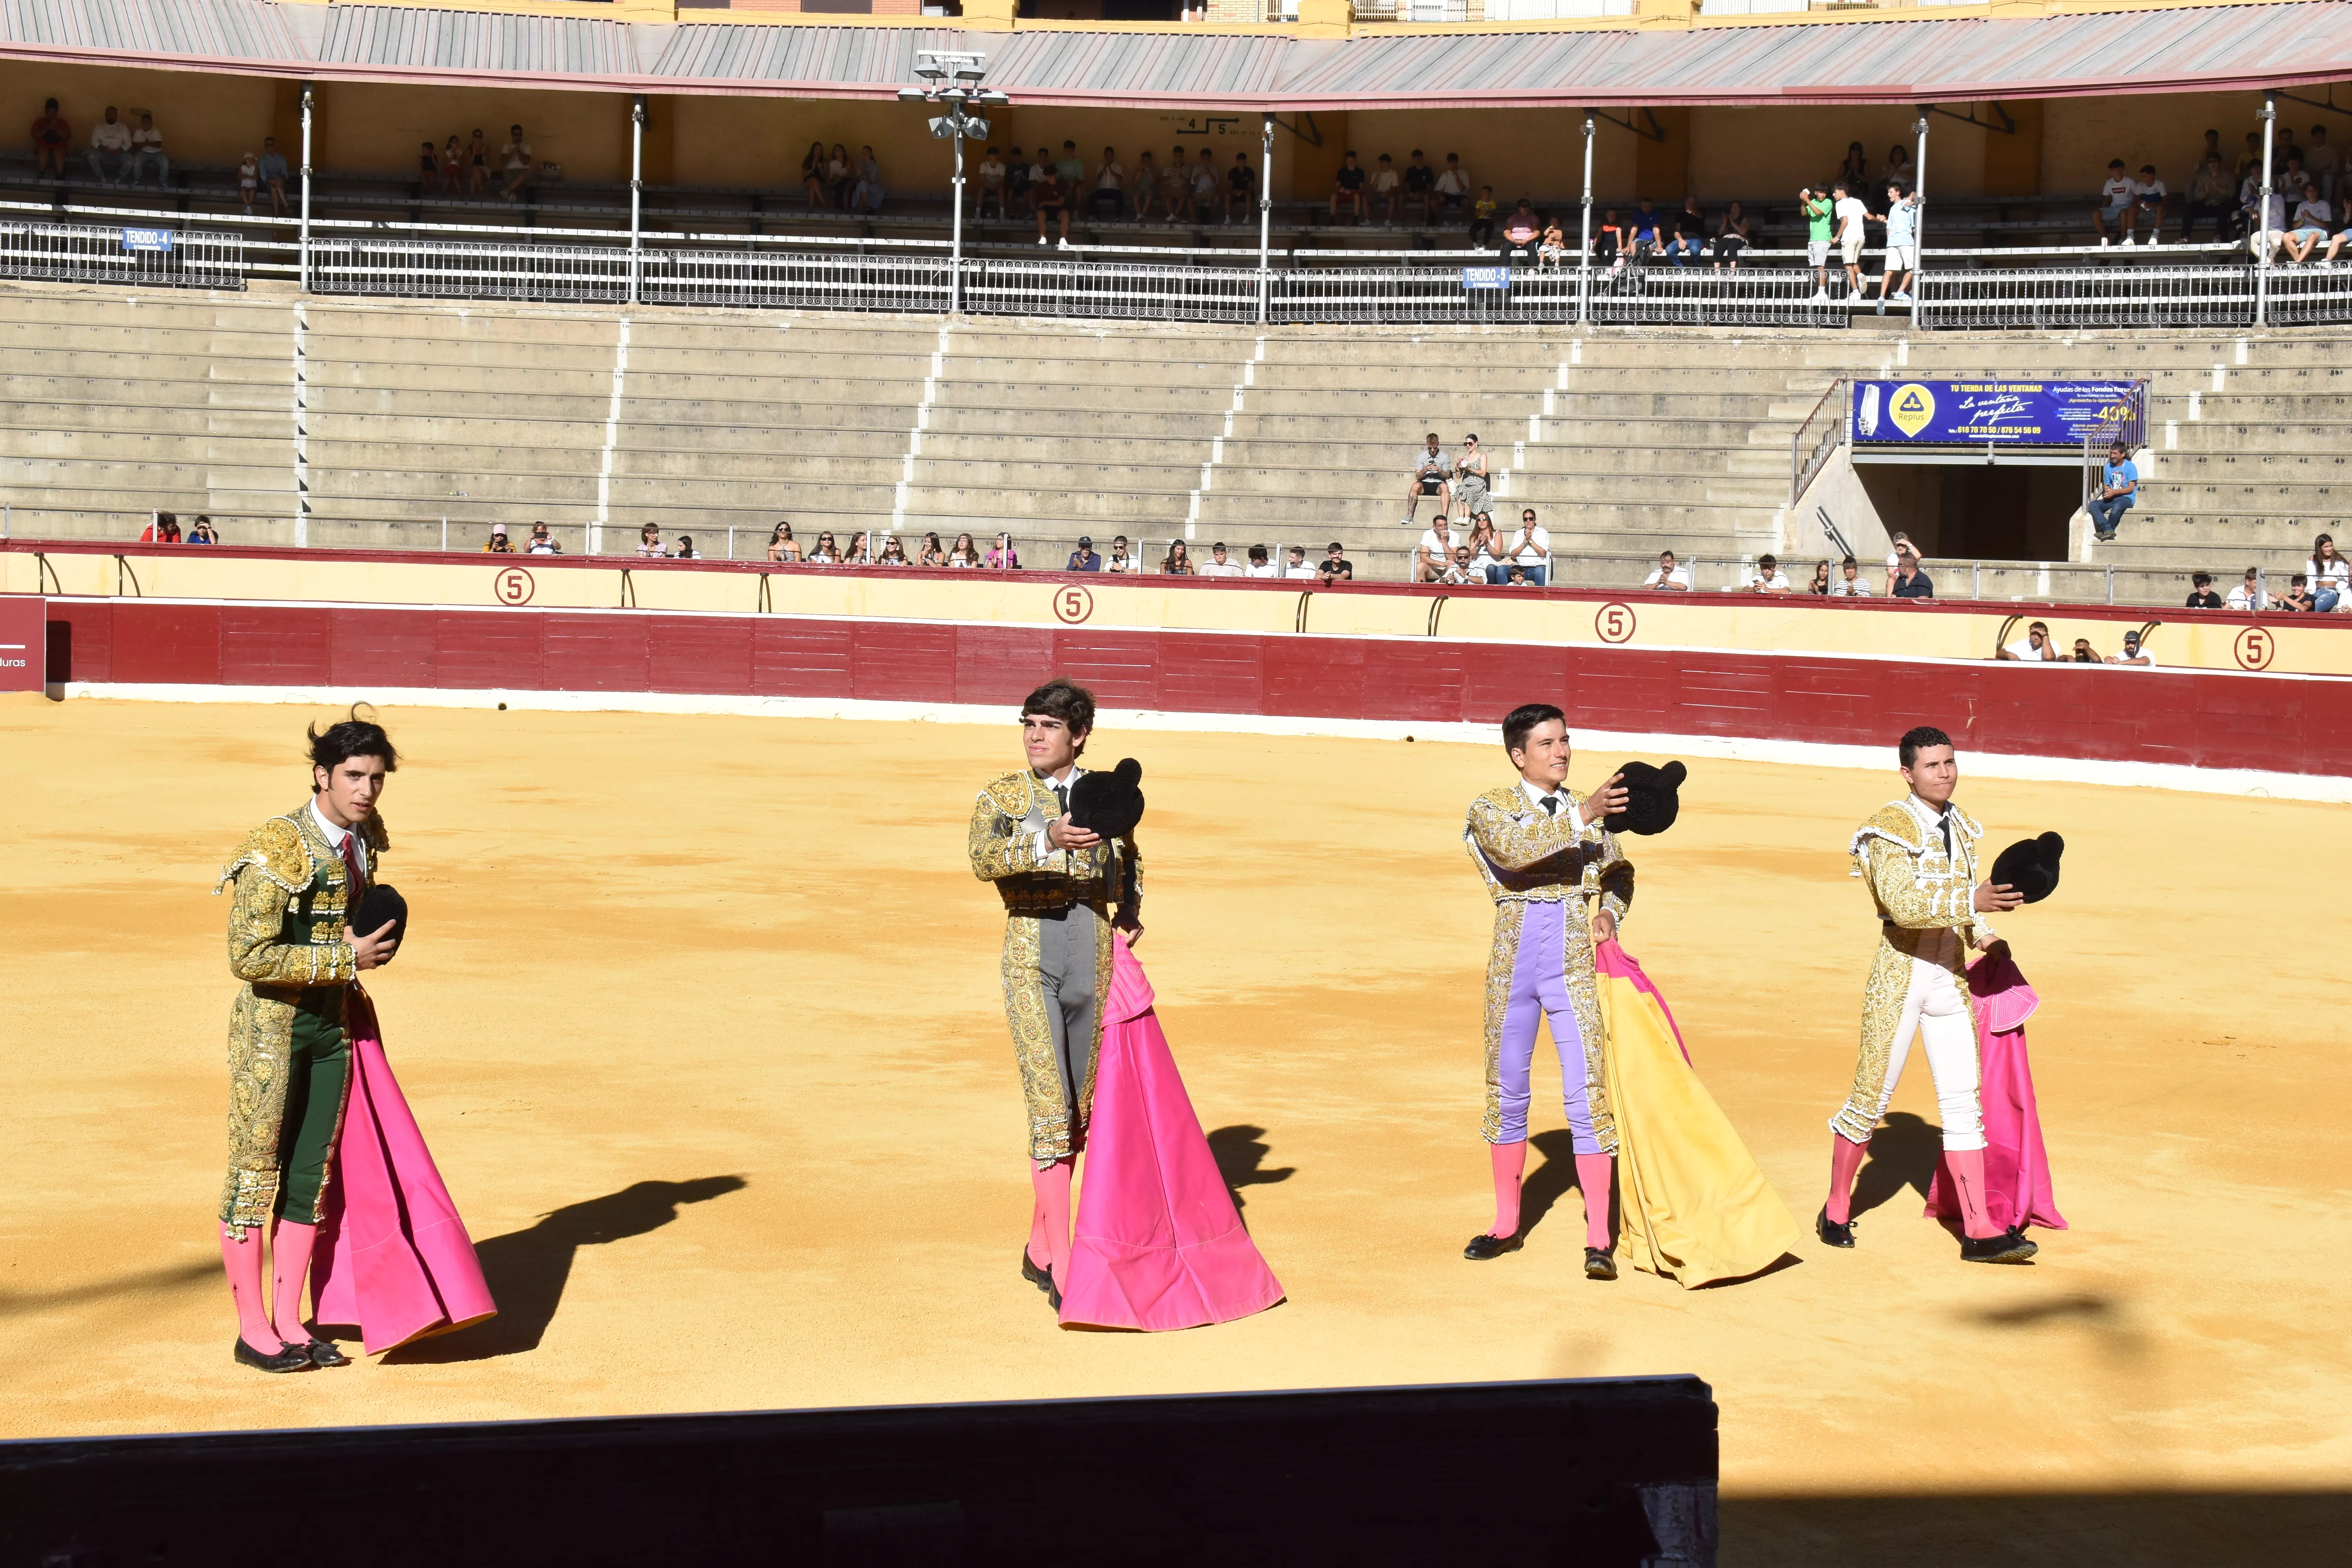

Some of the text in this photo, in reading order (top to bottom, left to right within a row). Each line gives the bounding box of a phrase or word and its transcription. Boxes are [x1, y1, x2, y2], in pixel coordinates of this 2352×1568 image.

[1189, 118, 1196, 129] 4
[1219, 124, 1226, 134] 5
[126, 230, 158, 244] TENDIDO
[1466, 269, 1496, 281] TENDIDO
[1959, 394, 2020, 408] La ventana
[1899, 413, 1924, 422] Replus
[1969, 401, 2033, 425] perfecta
[2092, 406, 2136, 421] -40%
[507, 576, 523, 599] 5
[1065, 592, 1082, 617] 5
[1608, 611, 1623, 636] 5
[2247, 635, 2263, 663] 5
[0, 657, 25, 667] uras
